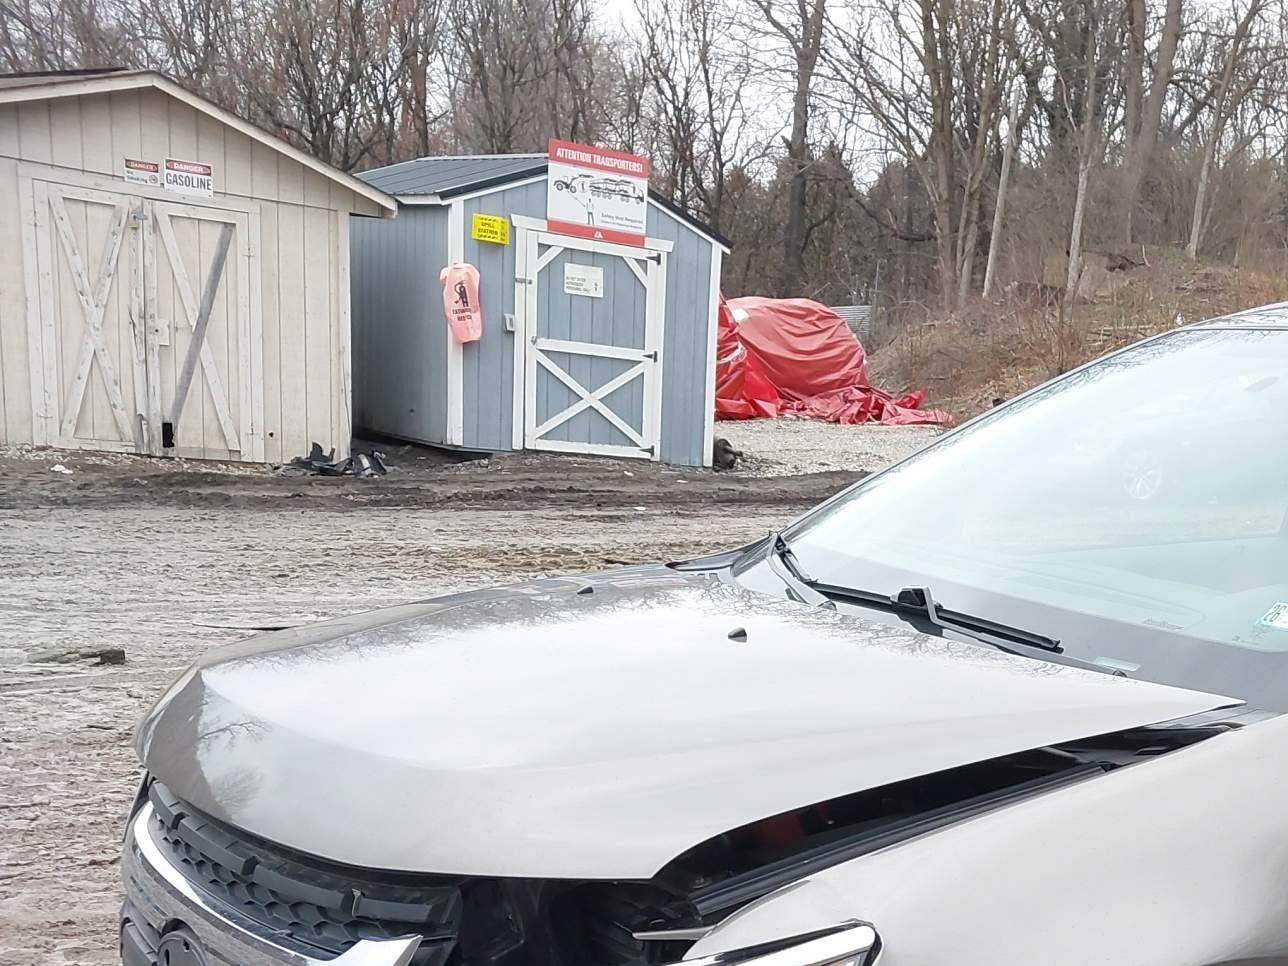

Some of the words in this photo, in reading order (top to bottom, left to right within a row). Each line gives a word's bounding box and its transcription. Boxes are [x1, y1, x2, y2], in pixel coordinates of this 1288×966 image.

[174, 163, 203, 173] DANGER
[556, 147, 592, 164] ATTENTION
[591, 153, 643, 173] TRANSPORTERS!
[165, 172, 212, 191] GASOLINE
